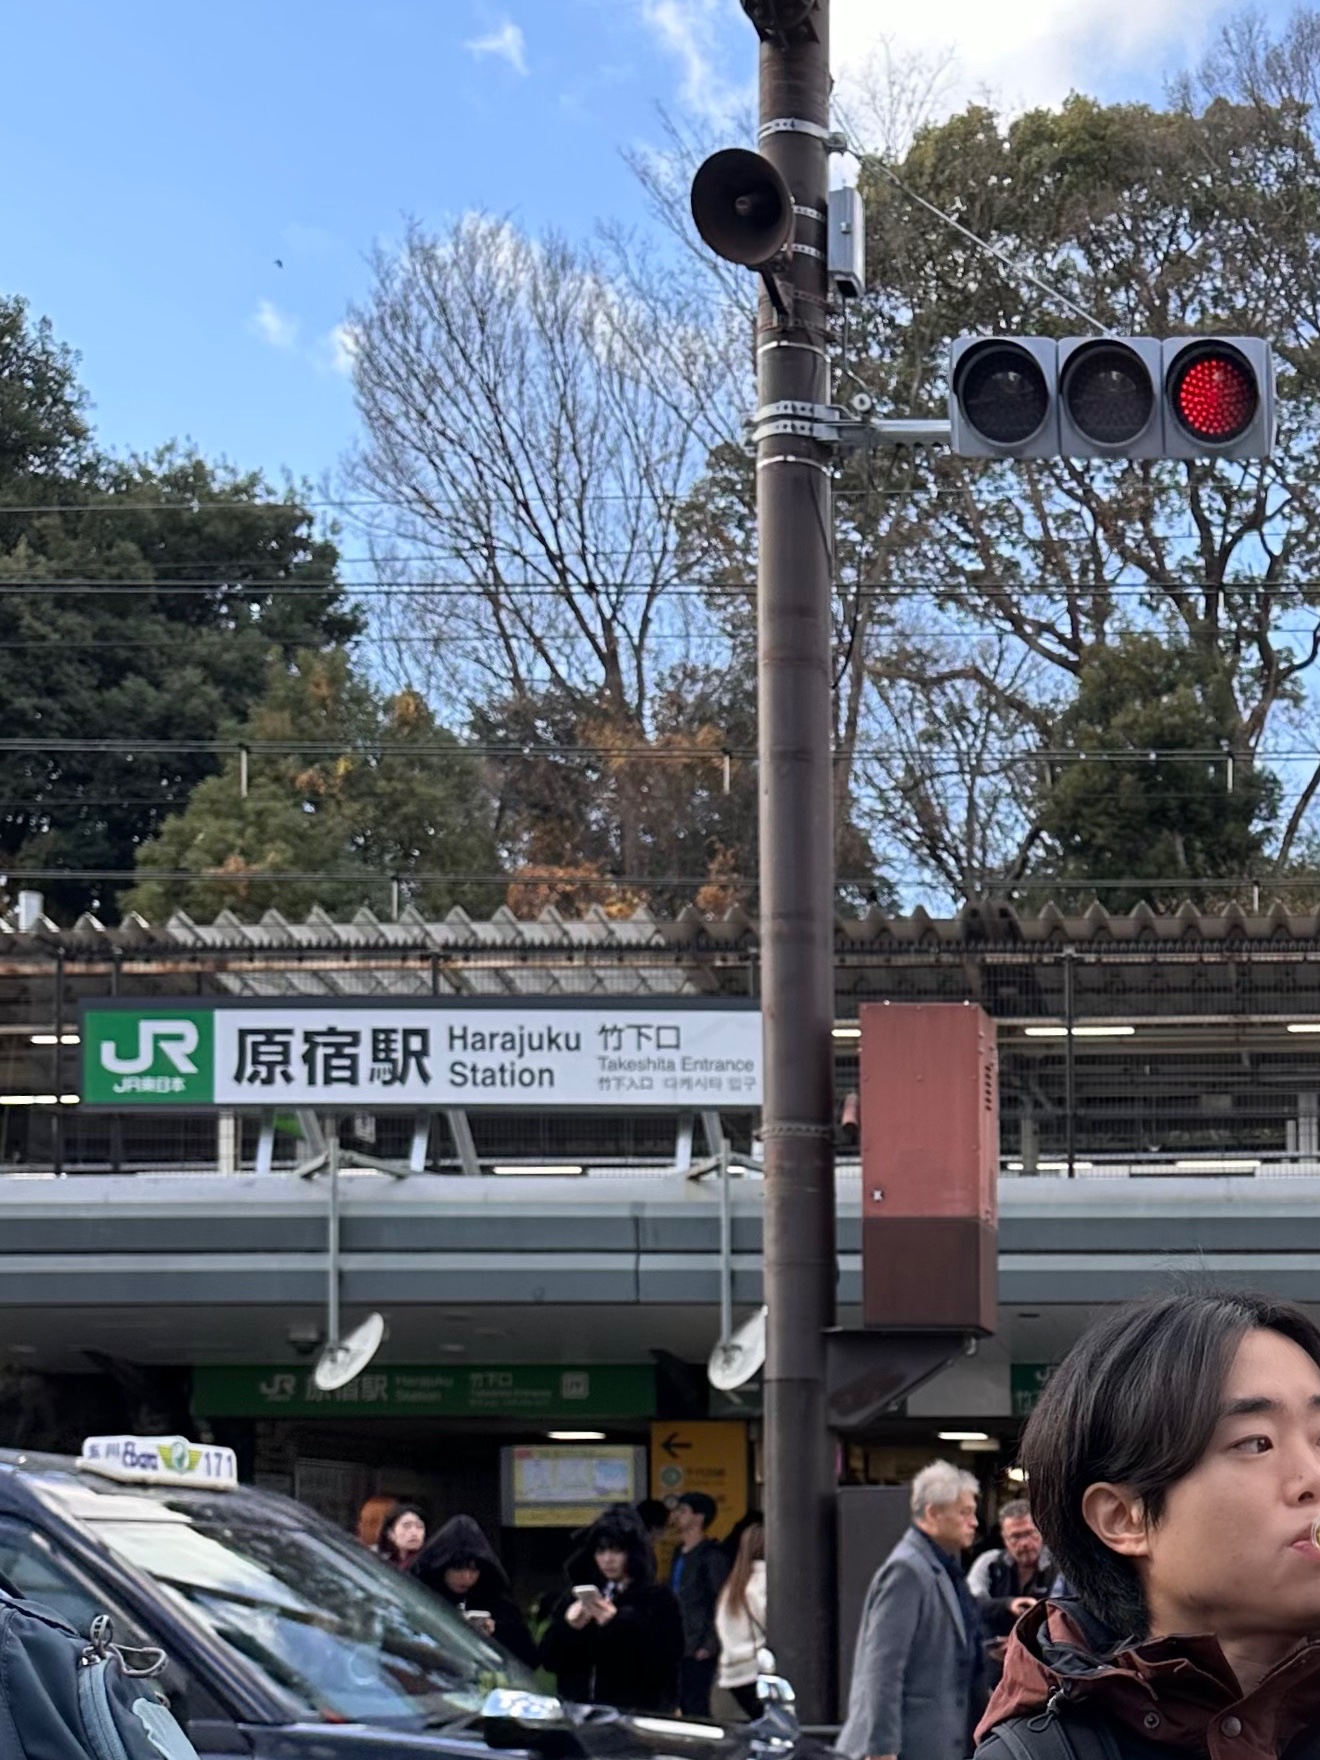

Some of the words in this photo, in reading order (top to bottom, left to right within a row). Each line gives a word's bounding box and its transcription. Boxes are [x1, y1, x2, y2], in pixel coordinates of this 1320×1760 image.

[101, 1019, 199, 1075] JR
[448, 1025, 582, 1058] Harajuku
[598, 1023, 680, 1051] 竹下口
[233, 1026, 432, 1087] 原宿駅
[597, 1054, 677, 1073] Takeshita
[680, 1054, 756, 1073] Entrance
[113, 1076, 186, 1094] JR東日本
[449, 1060, 556, 1088] Station
[204, 1451, 234, 1479] 171
